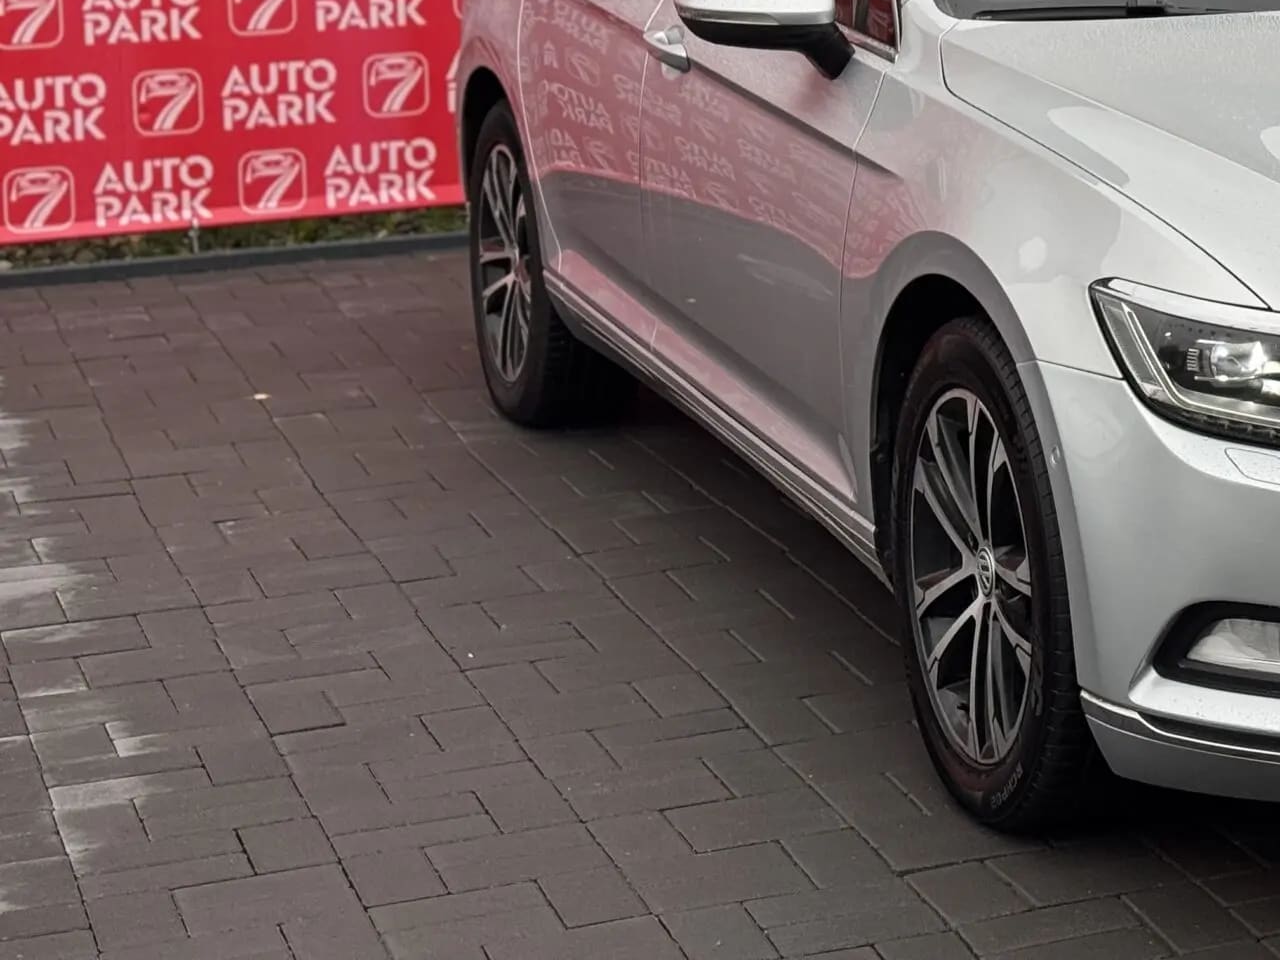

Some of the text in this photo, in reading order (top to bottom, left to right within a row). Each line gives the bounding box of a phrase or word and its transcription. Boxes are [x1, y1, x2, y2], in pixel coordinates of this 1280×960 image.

[84, 8, 202, 45] PARK
[222, 59, 336, 94] AUTO
[222, 92, 335, 130] PARK
[324, 138, 436, 172] AUTO
[94, 156, 214, 192] AUTO
[325, 171, 436, 206] PARK
[95, 192, 212, 228] PARK
